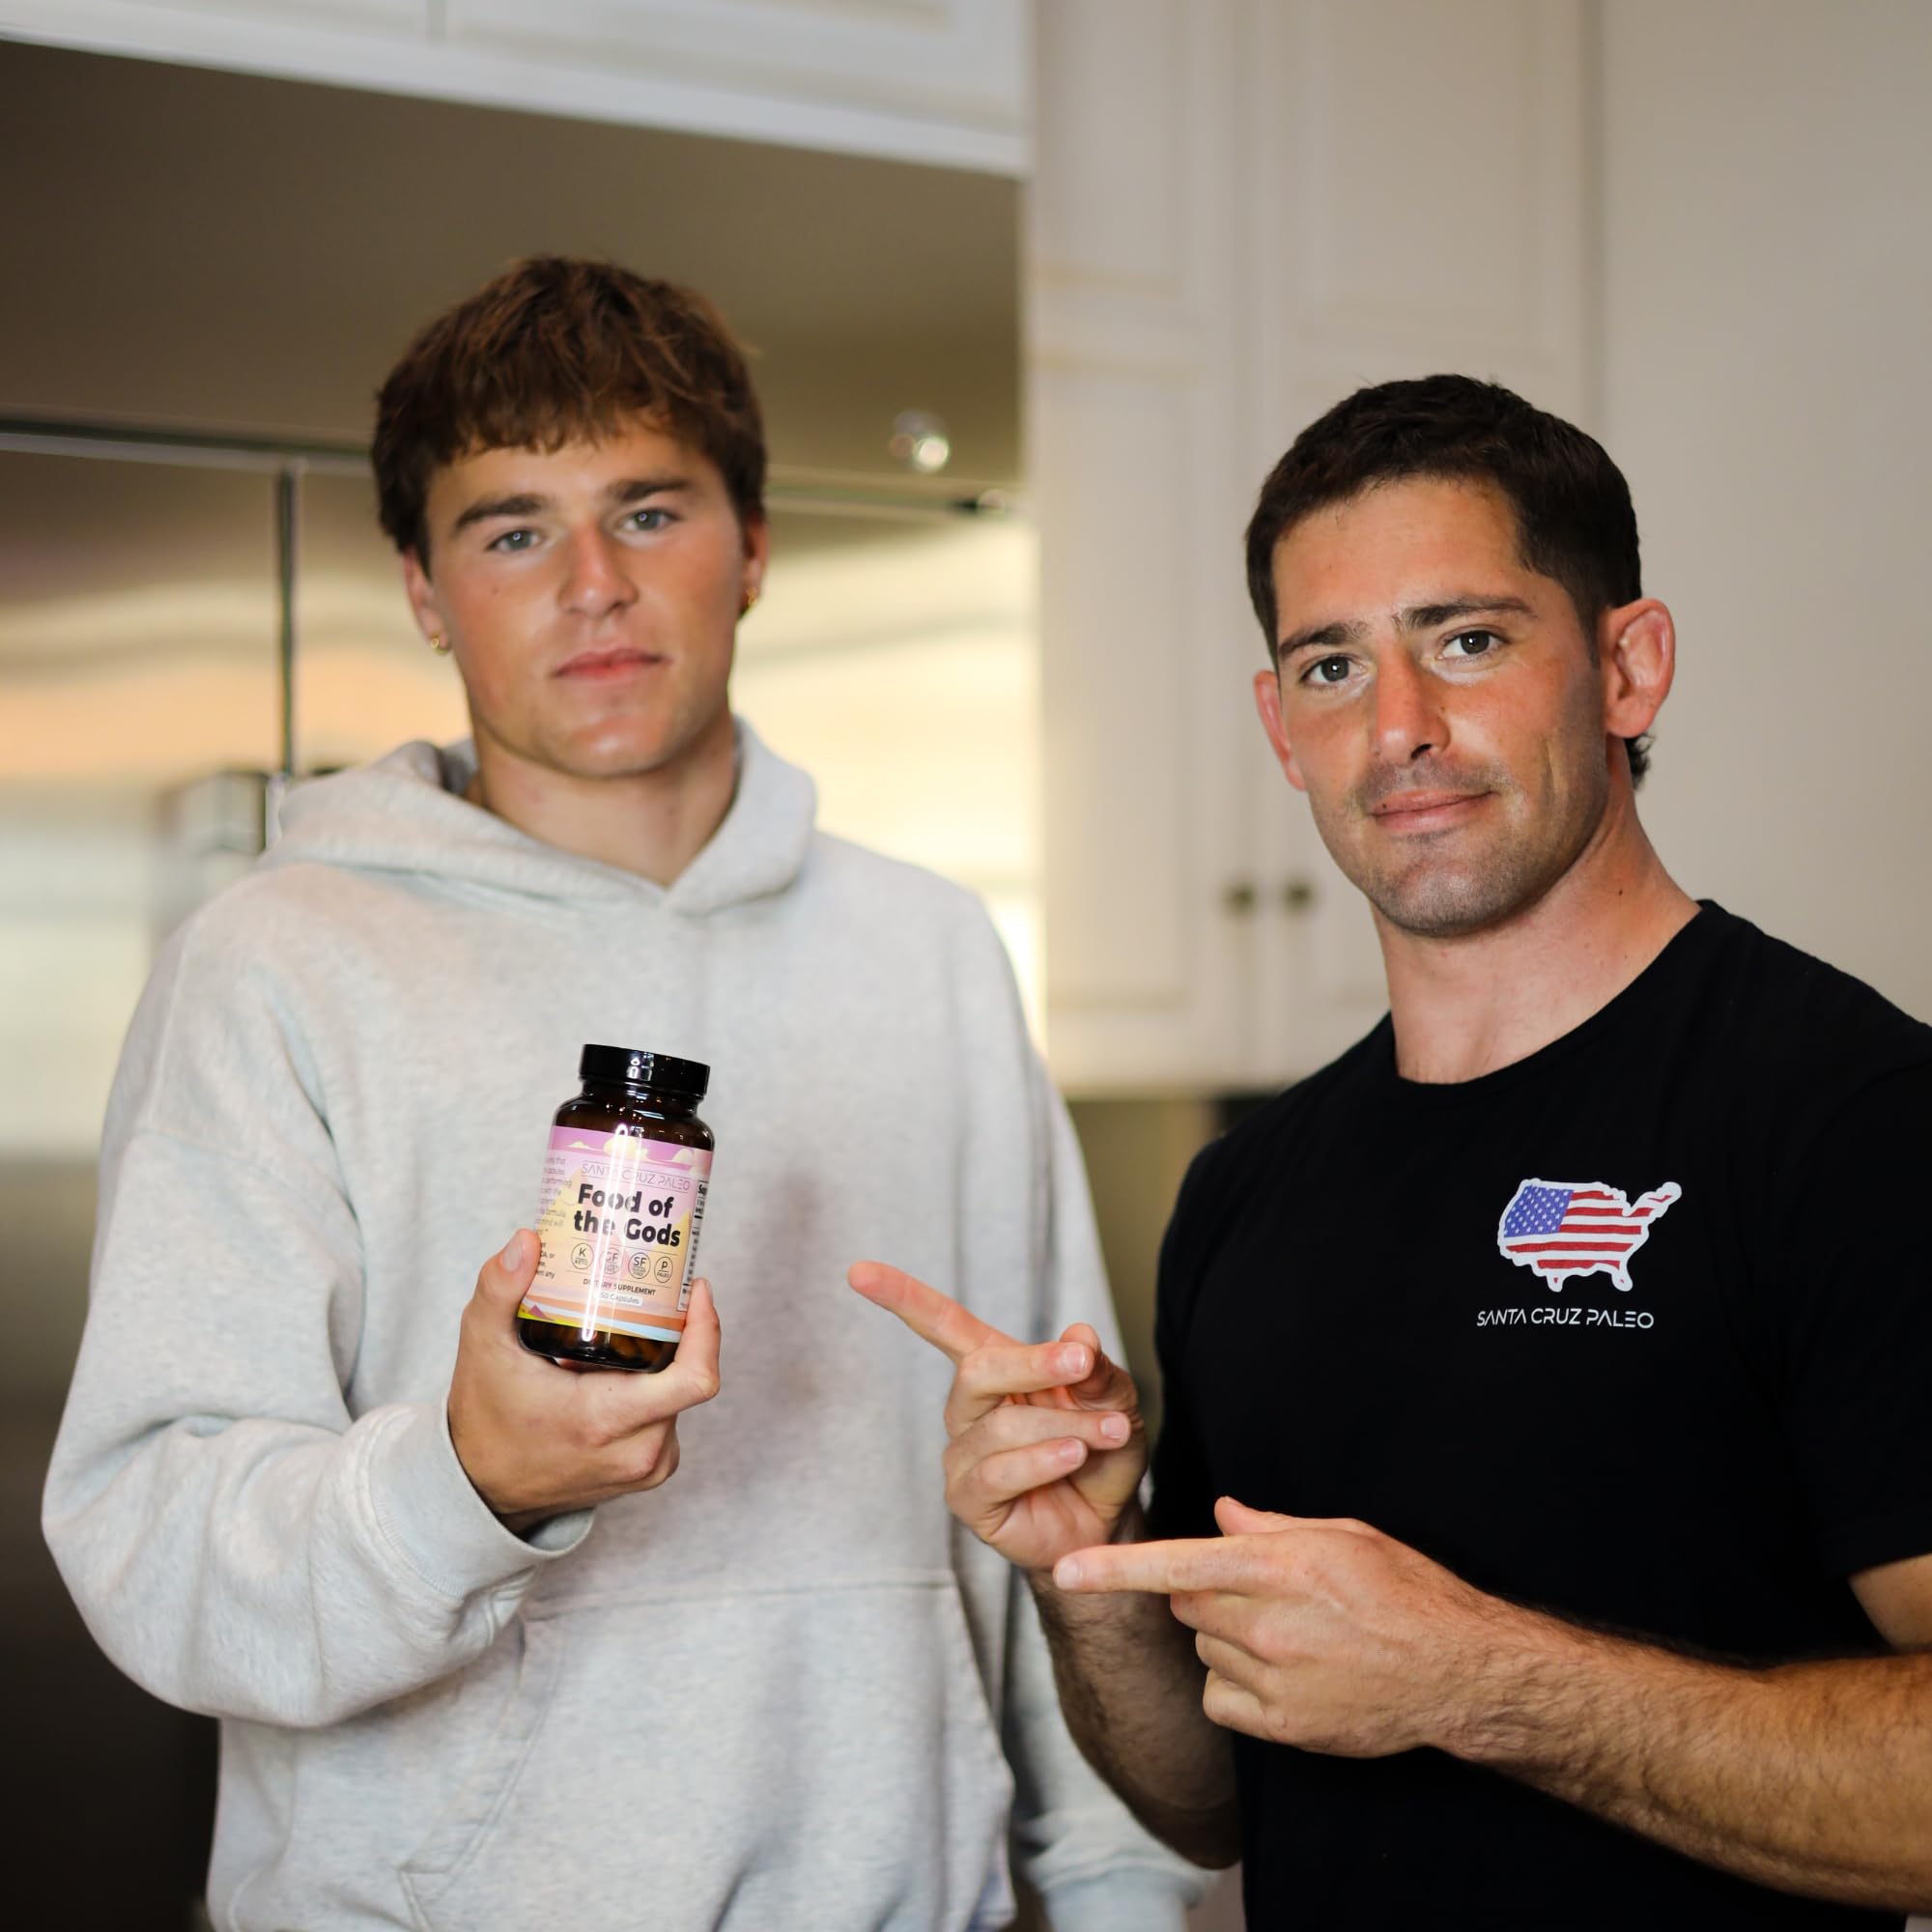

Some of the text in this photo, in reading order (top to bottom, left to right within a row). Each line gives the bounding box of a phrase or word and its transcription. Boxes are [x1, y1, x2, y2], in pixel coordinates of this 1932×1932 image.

[657, 1176, 691, 1191] PALEO
[578, 1183, 642, 1213] Food
[648, 1196, 674, 1218] of
[574, 1210, 681, 1247] the Gods
[579, 1247, 587, 1258] K
[634, 1256, 647, 1266] SF
[662, 1261, 668, 1269] P
[582, 1278, 656, 1295] DITRY SUPPLEMENT
[1476, 1308, 1655, 1329] SANTA CRUZ PALEO
